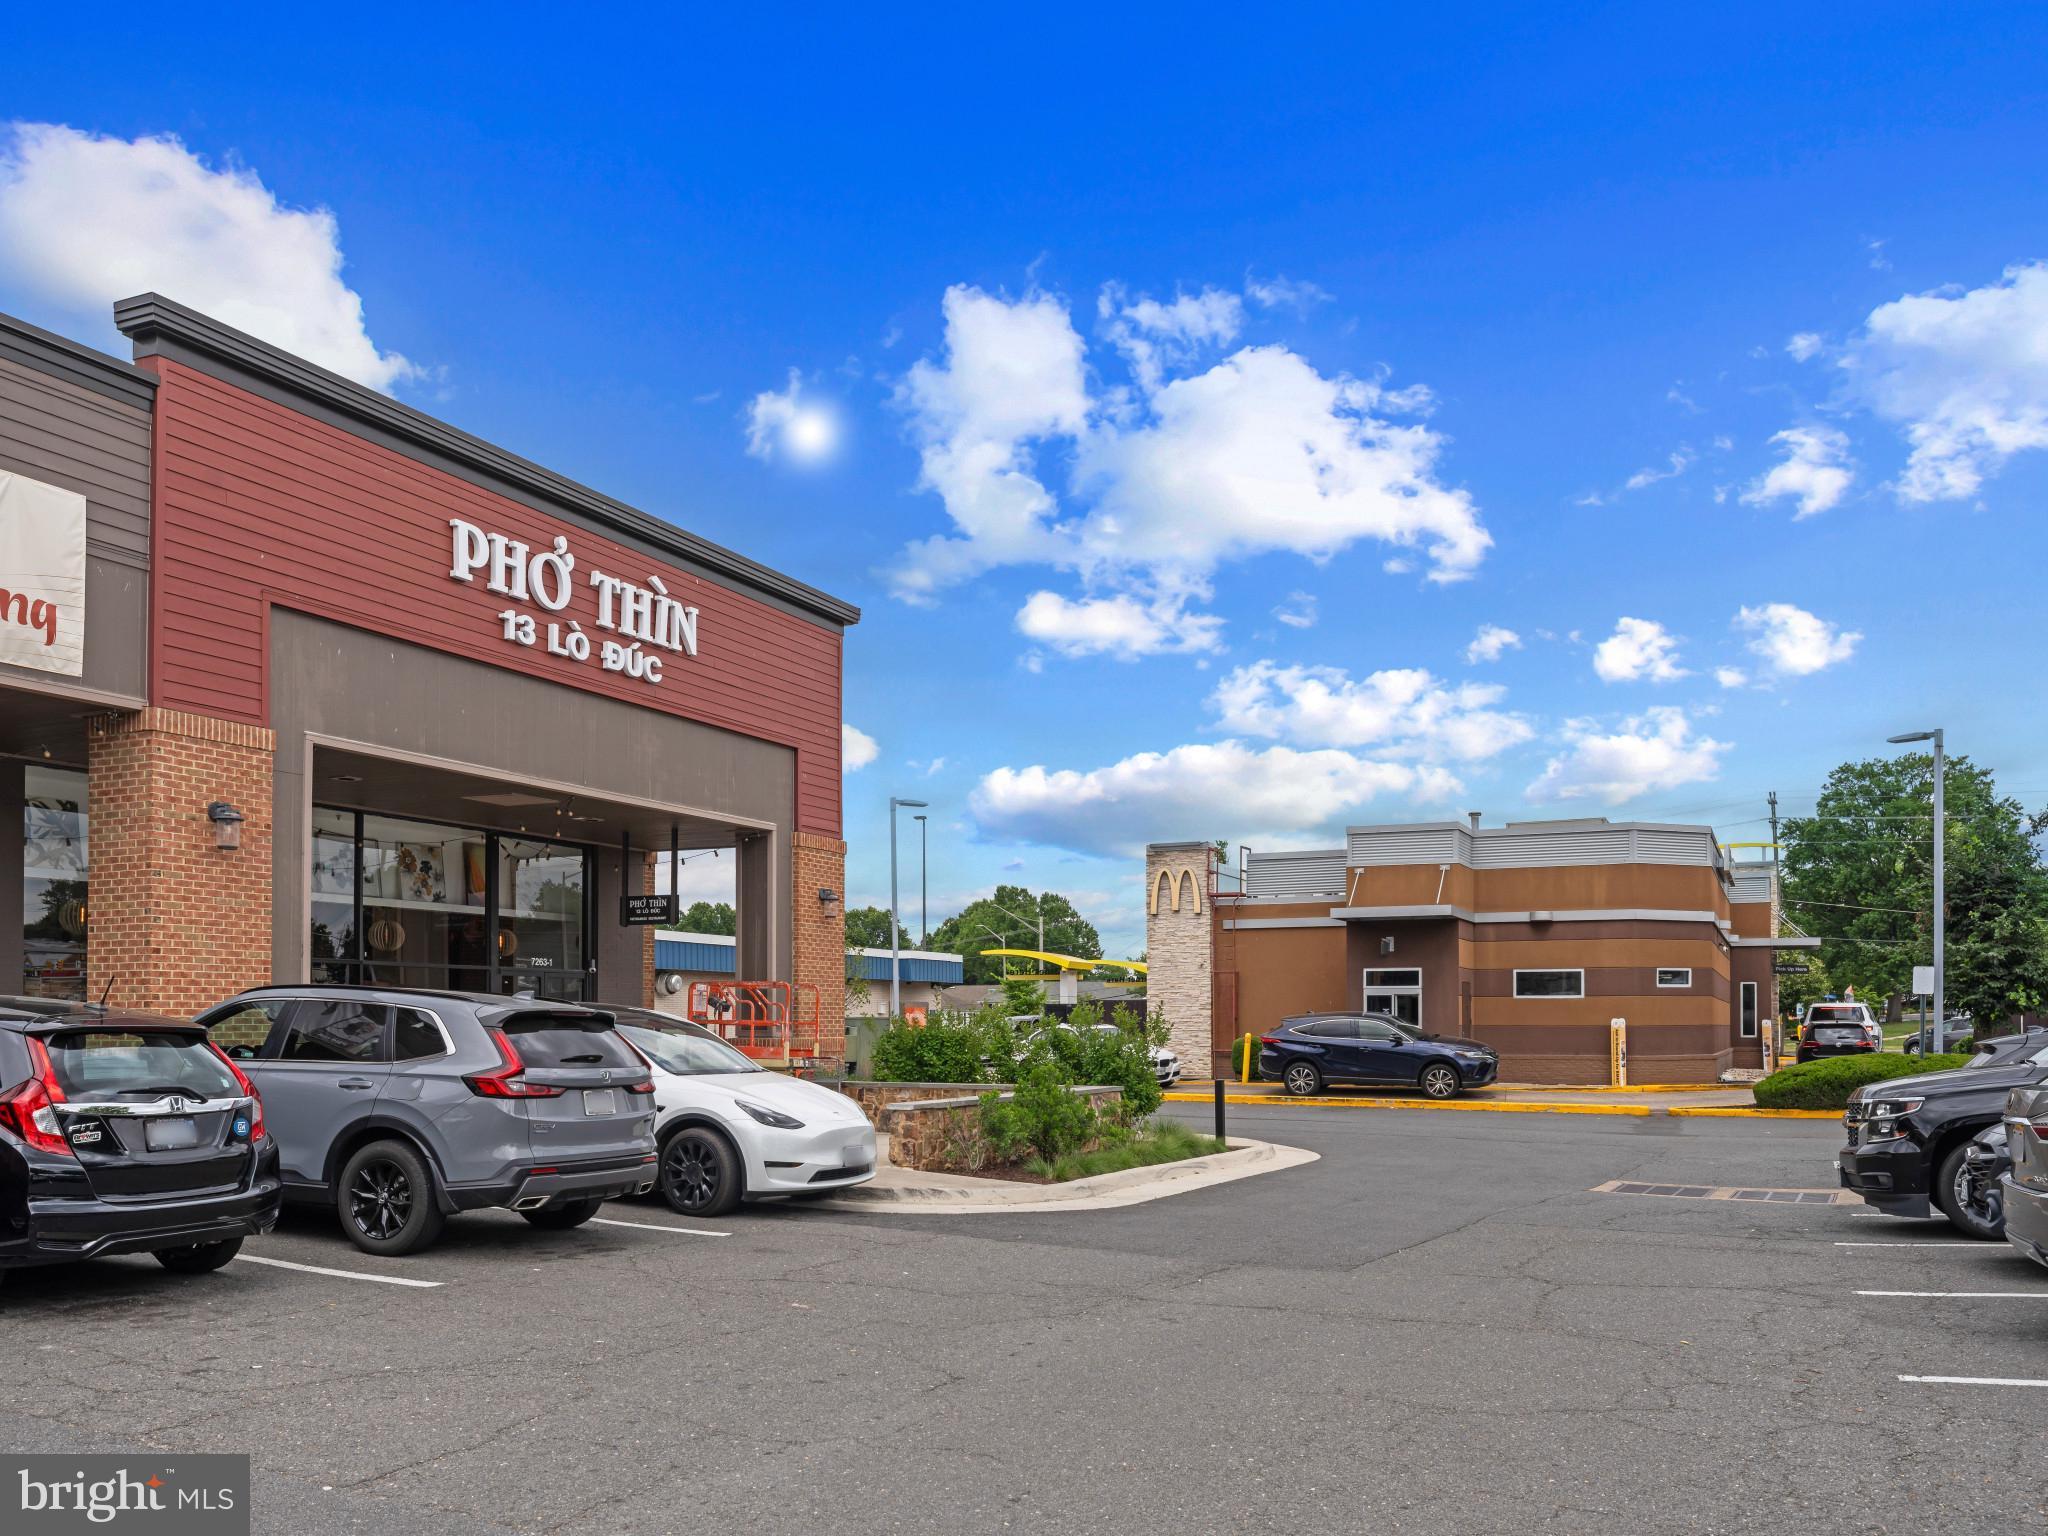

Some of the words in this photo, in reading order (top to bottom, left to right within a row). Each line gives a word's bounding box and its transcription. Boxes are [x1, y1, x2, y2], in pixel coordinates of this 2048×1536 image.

[449, 518, 575, 611] PHỞ
[589, 570, 699, 656] THÌN
[498, 609, 537, 646] 13
[547, 620, 591, 661] LÒ
[601, 640, 663, 684] ĐÚC
[531, 957, 553, 967] 7263-1
